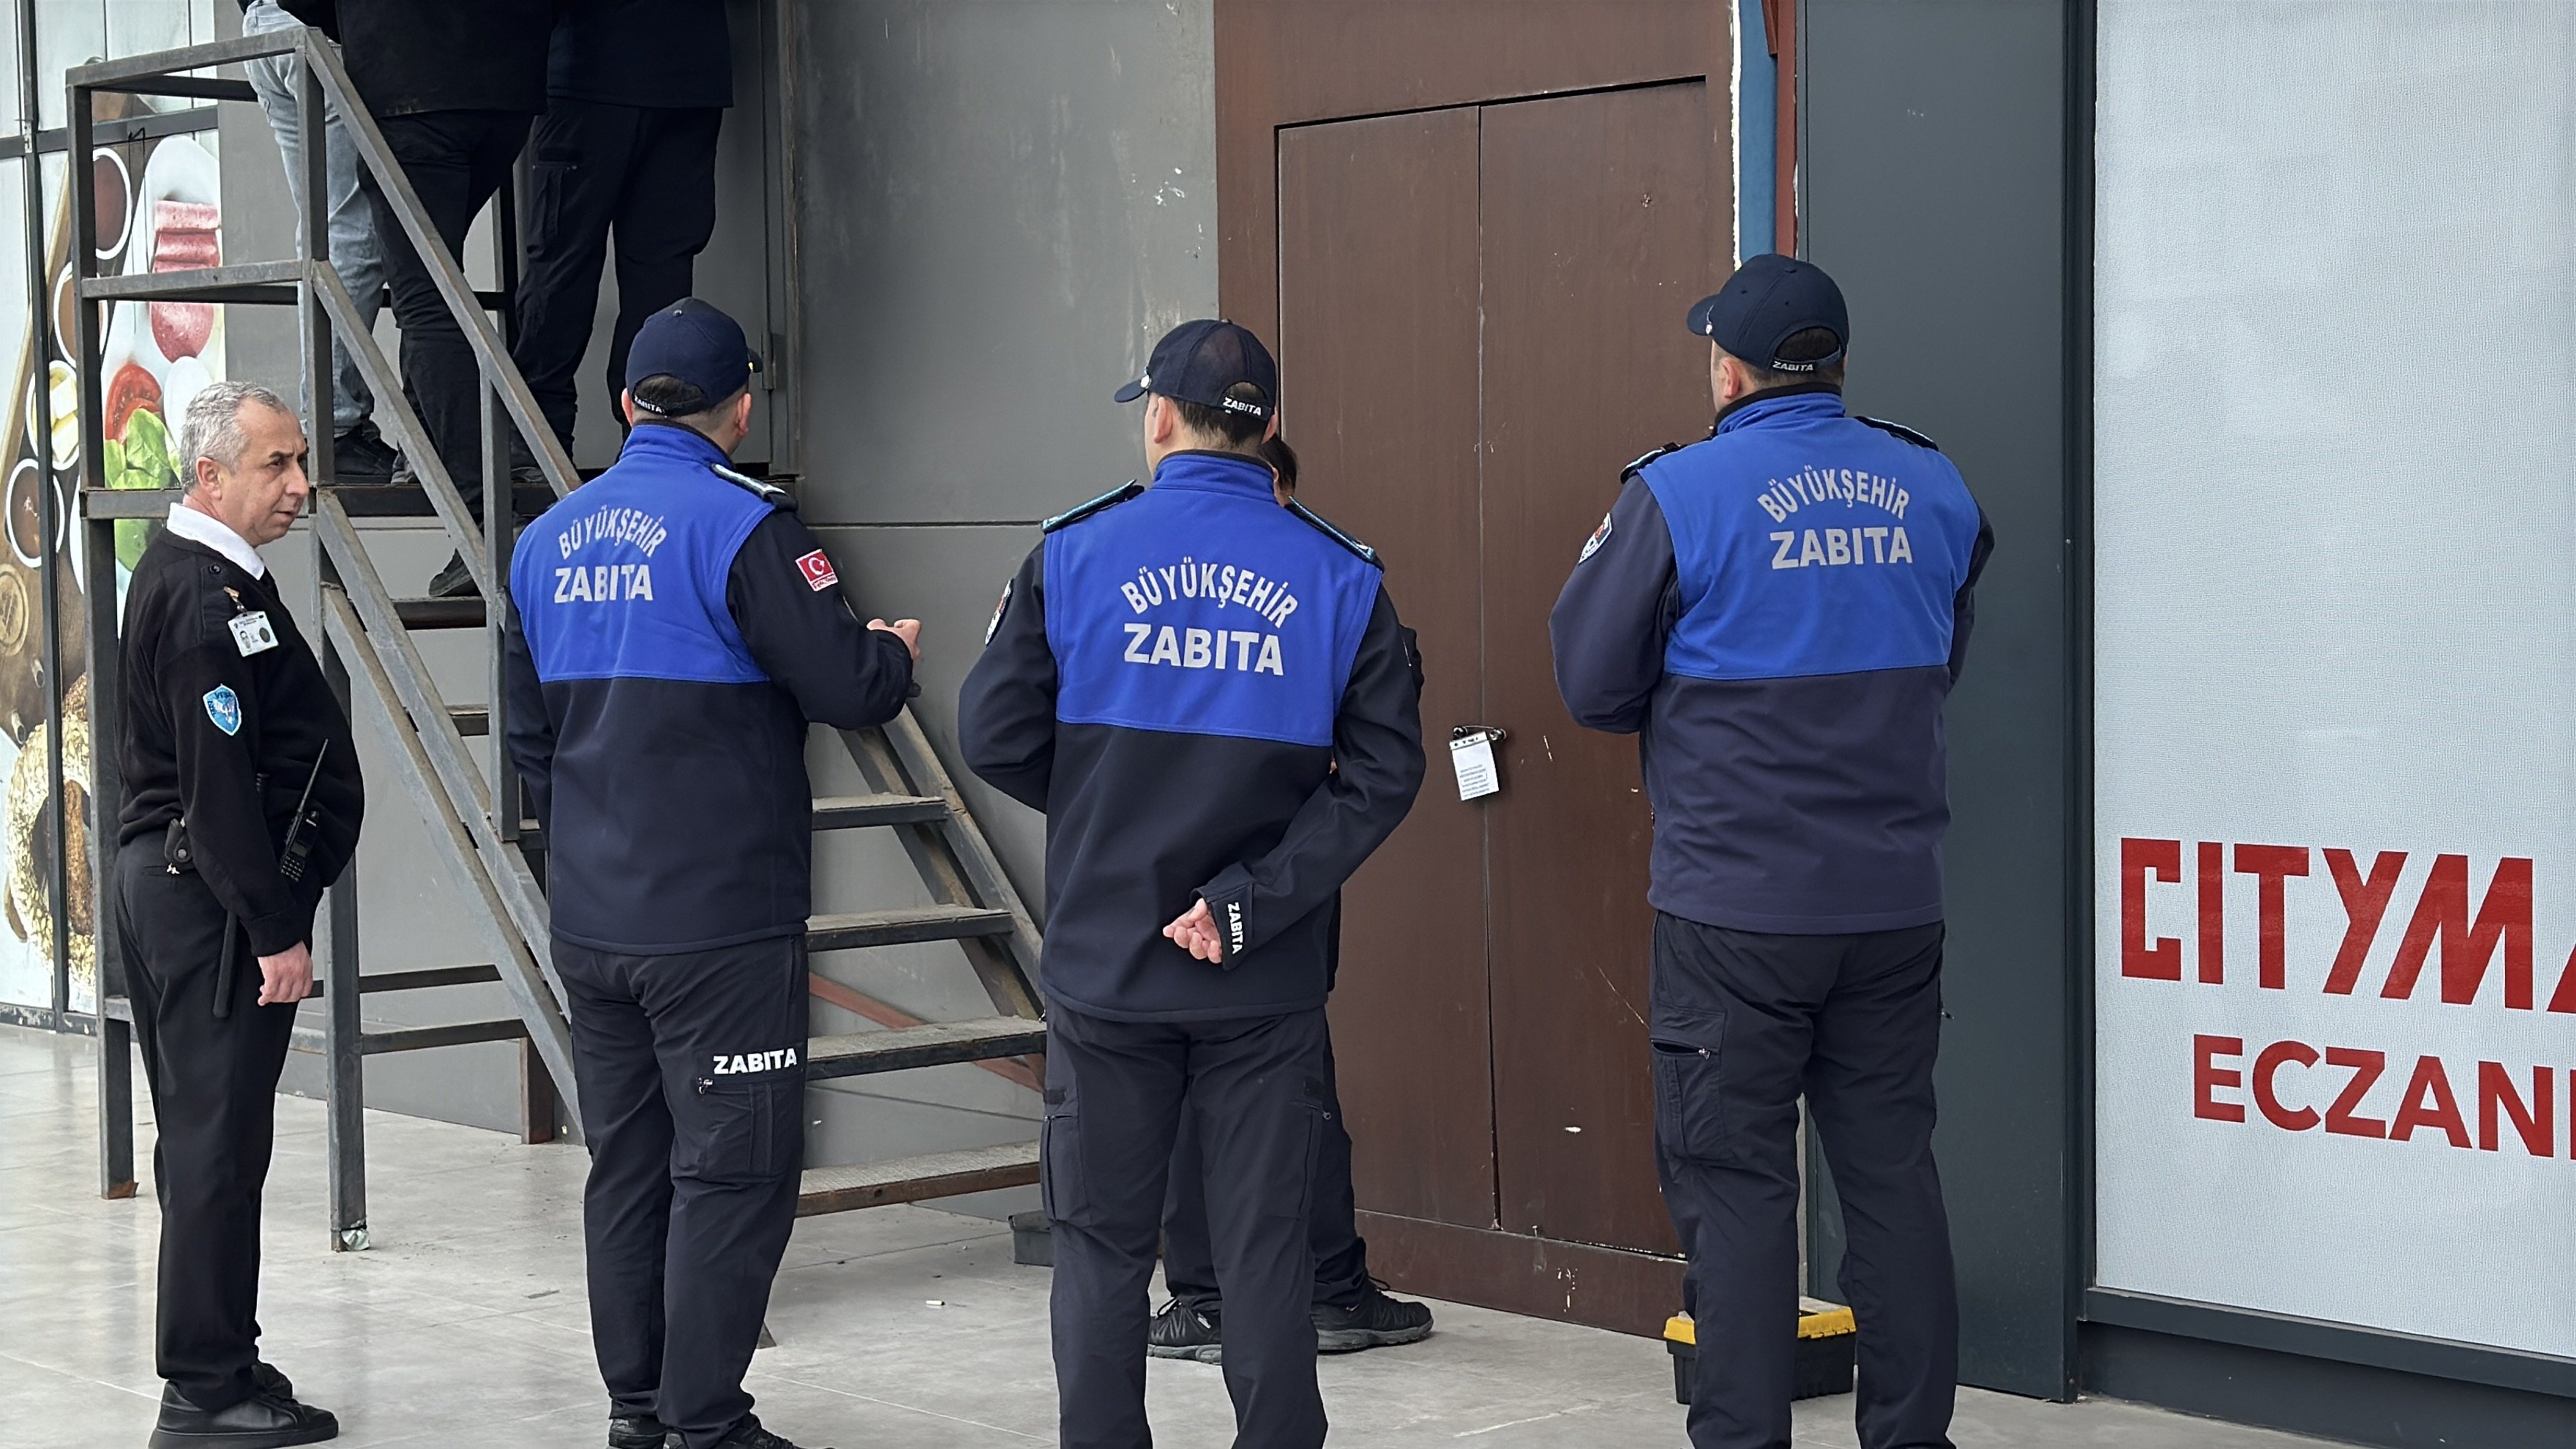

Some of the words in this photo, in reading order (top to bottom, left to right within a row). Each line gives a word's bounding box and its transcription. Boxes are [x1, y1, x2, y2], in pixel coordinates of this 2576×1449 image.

[1772, 361, 1814, 372] ZABITA
[1222, 396, 1262, 416] ZABITA
[1757, 465, 1911, 524] BÜYÜKŞEHİR
[558, 505, 668, 560] BÜYÜKŞEHİR
[1770, 526, 1913, 570] ZABITA
[554, 564, 654, 604] ZABITA
[1120, 556, 1298, 629] BÜYÜKŞEHİR
[1123, 622, 1284, 676] ZABITA
[1227, 902, 1243, 954] ZABITA
[713, 1048, 798, 1075] ZABITA
[2194, 1034, 2576, 1161] ECZAN
